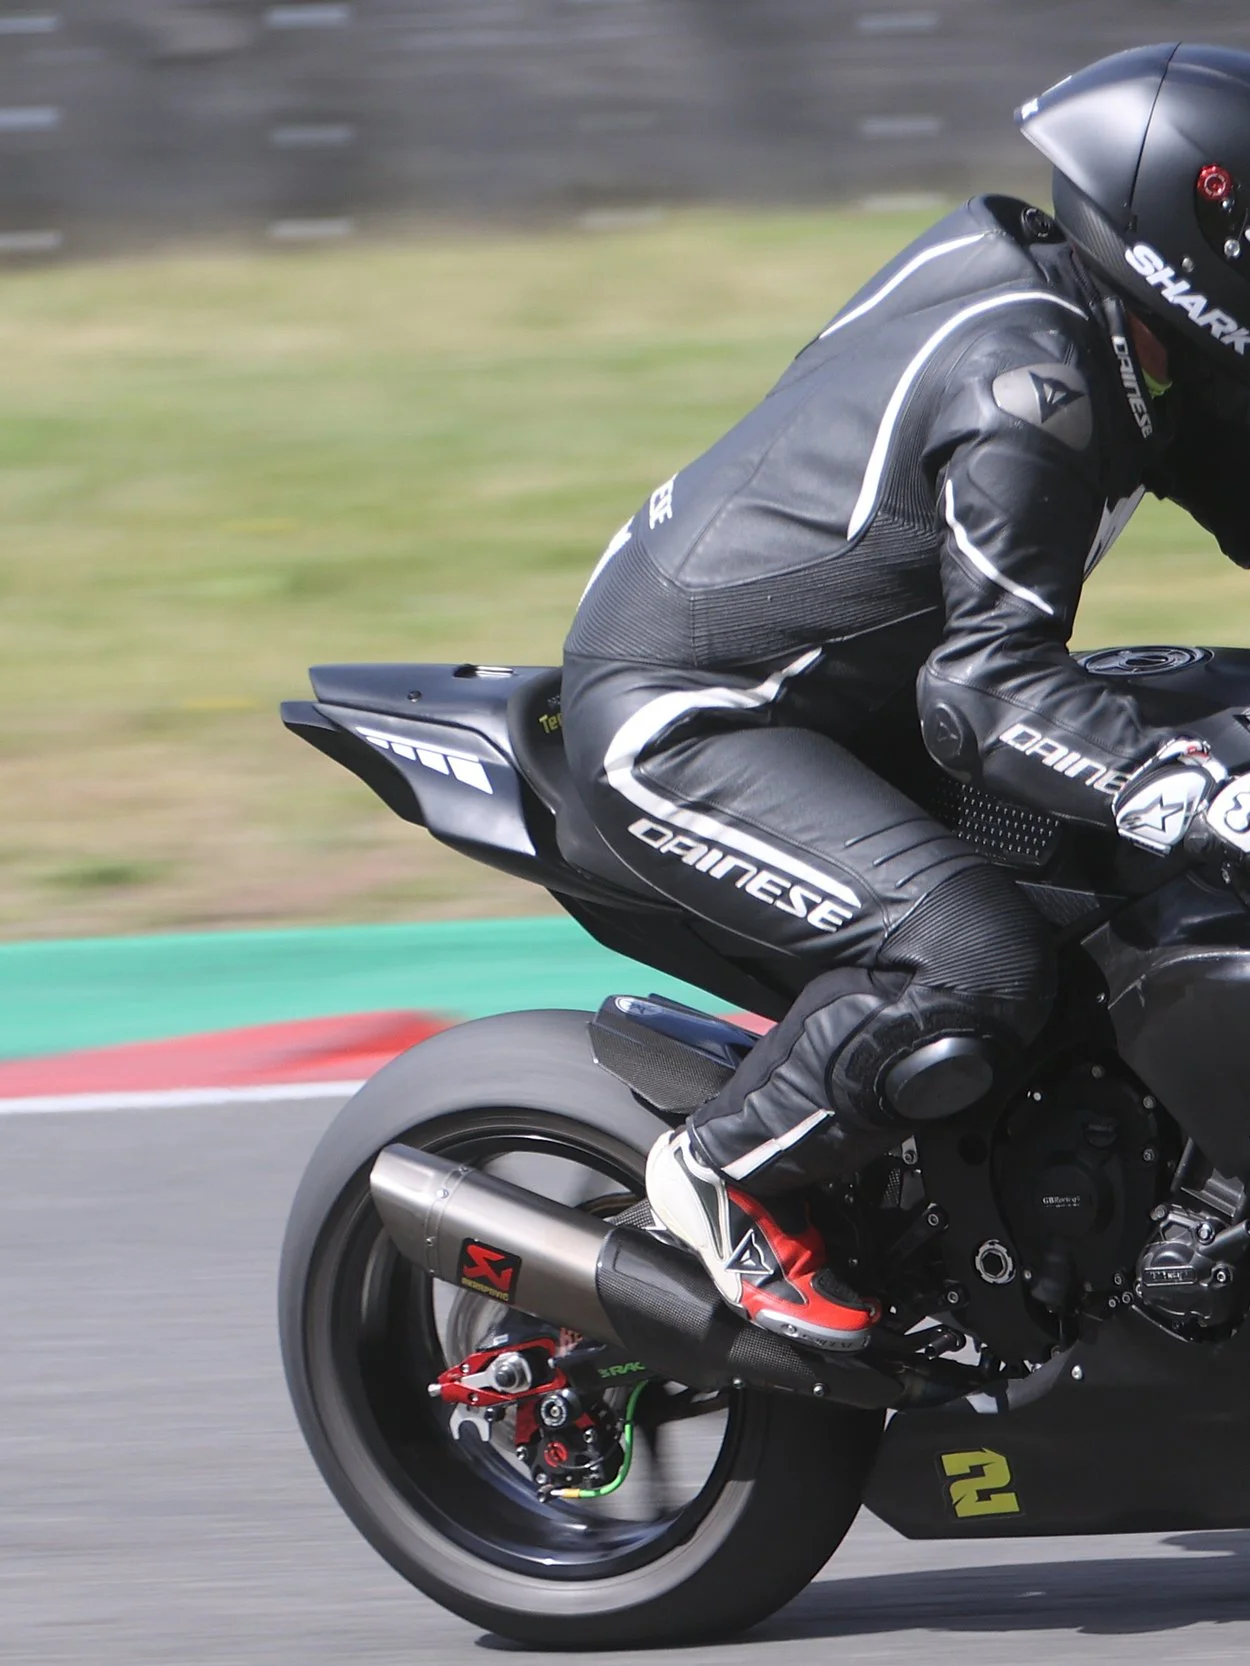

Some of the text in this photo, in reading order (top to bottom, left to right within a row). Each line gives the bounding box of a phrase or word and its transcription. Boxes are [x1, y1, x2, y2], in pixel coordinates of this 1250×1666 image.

[1111, 335, 1153, 439] DAINESE
[1000, 723, 1132, 795] DAINE
[627, 818, 853, 933] DAINESE
[940, 1446, 1021, 1518] 2
